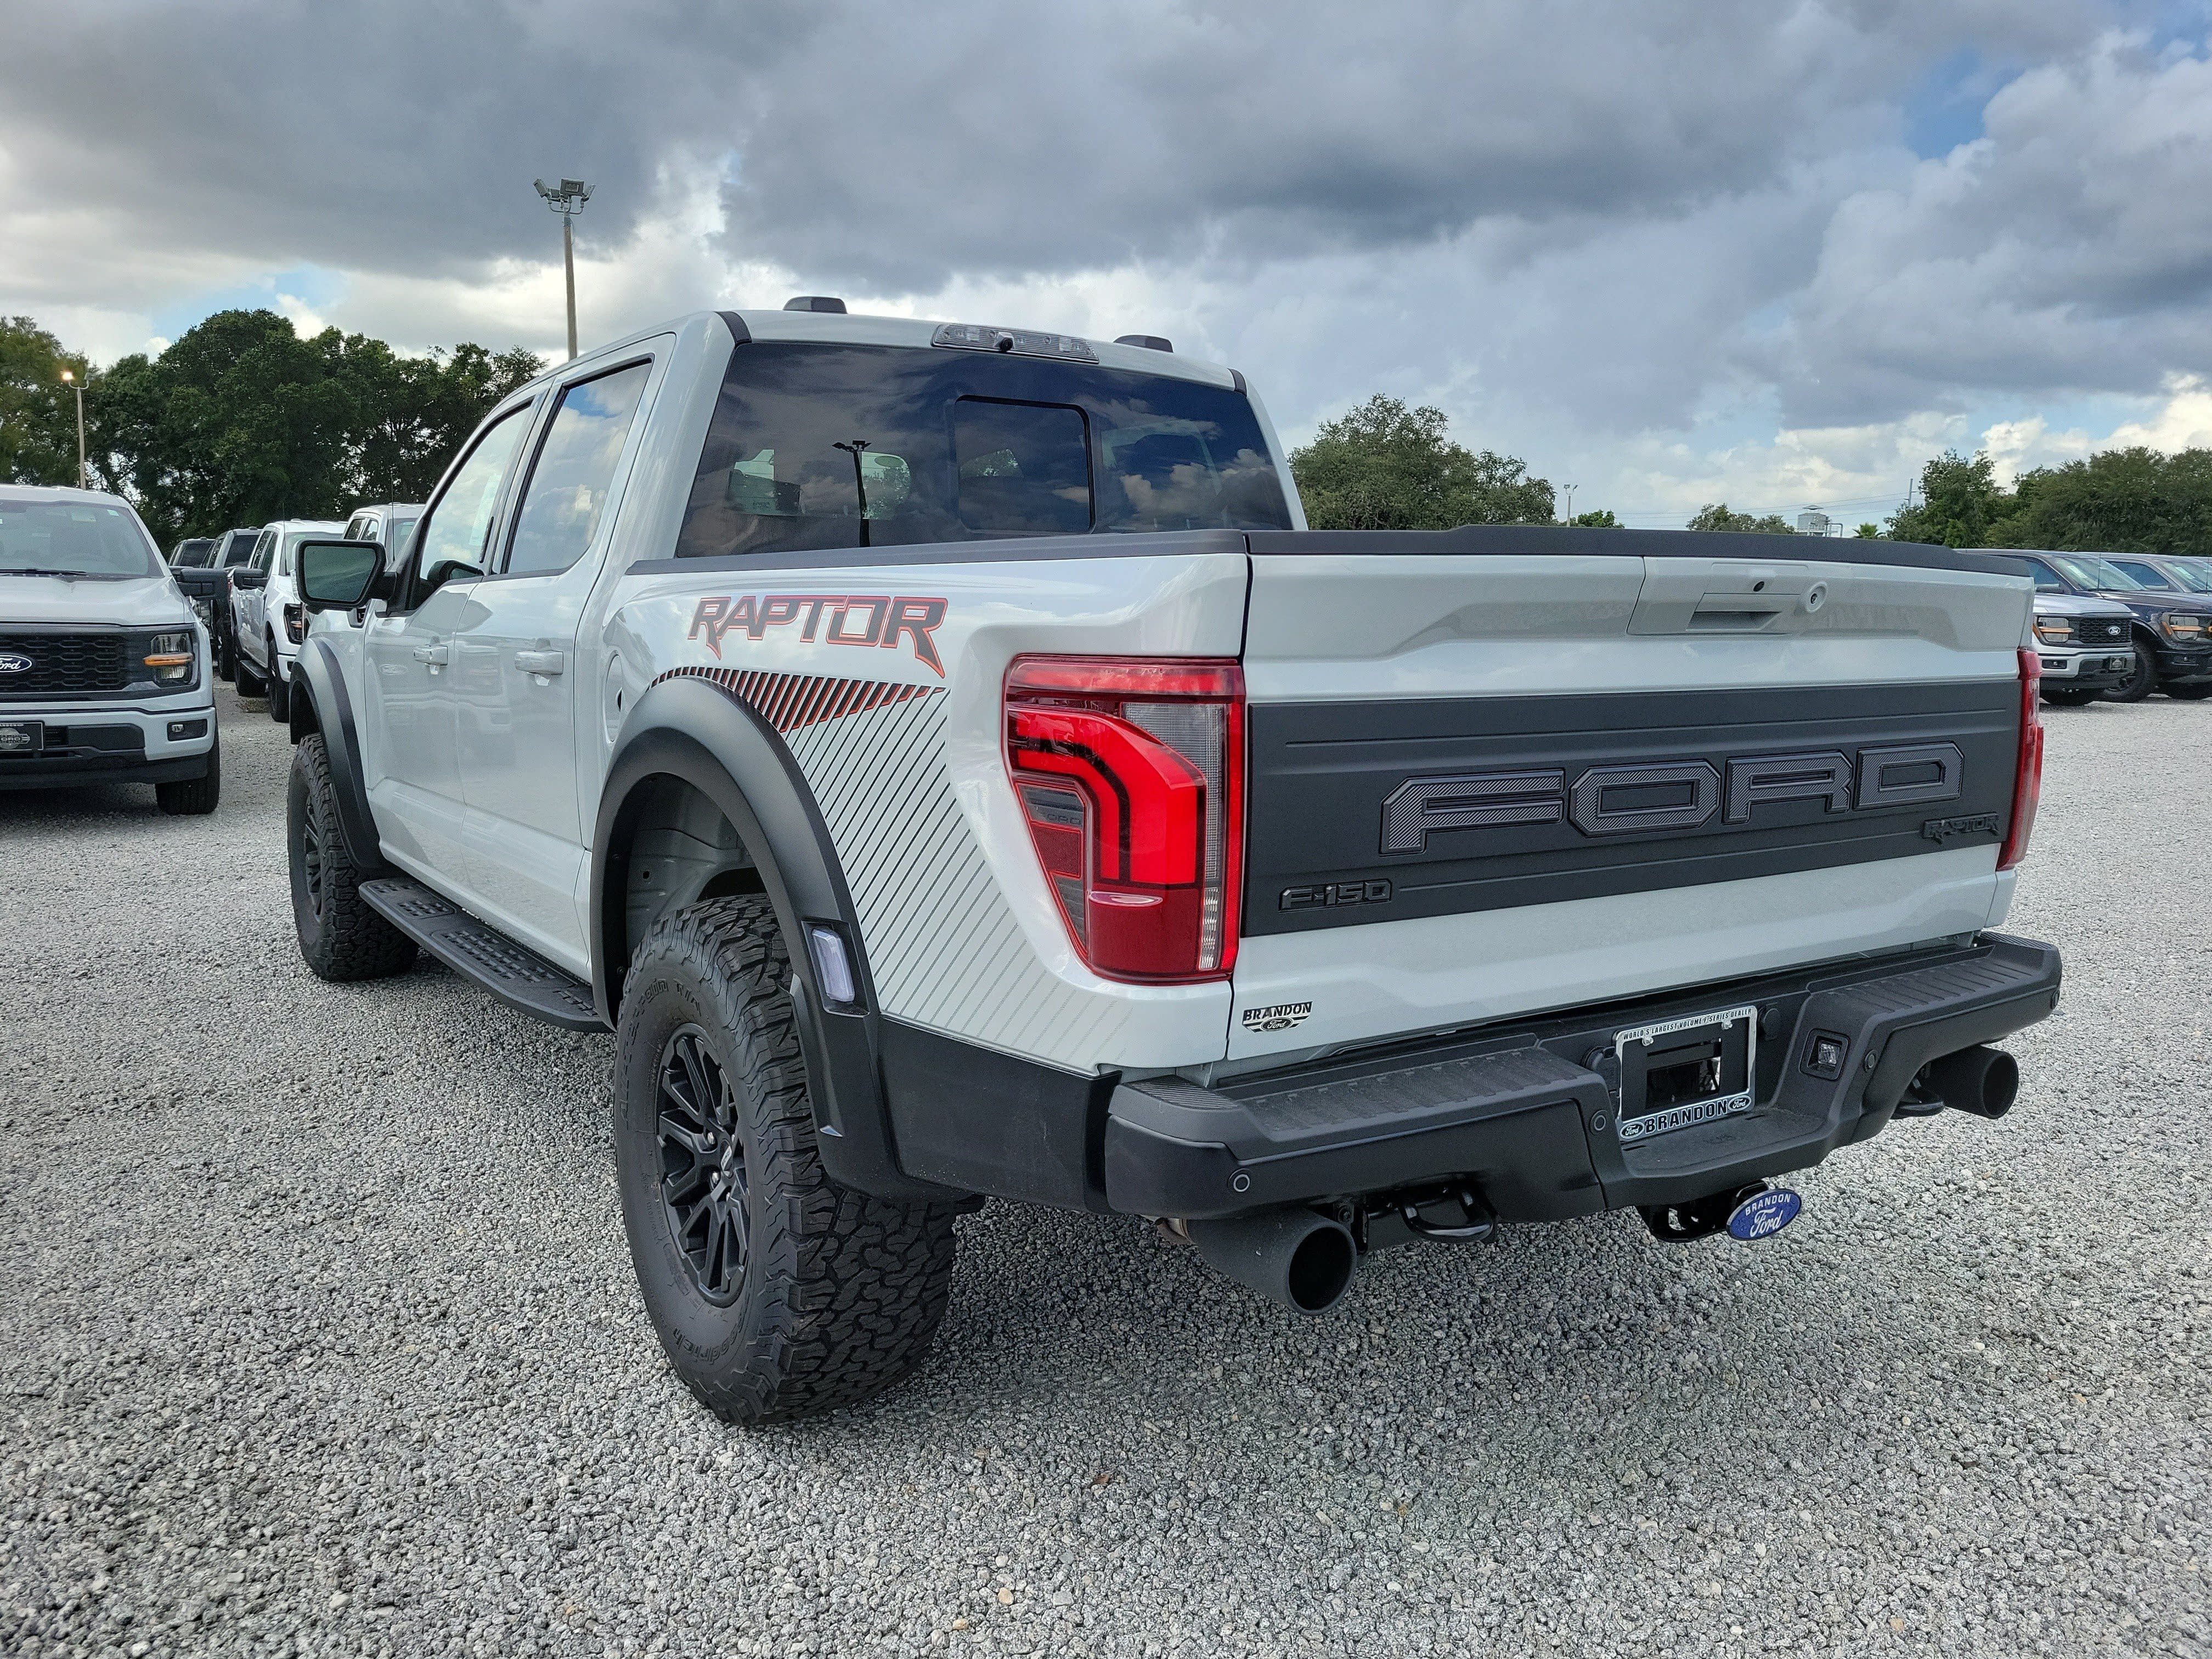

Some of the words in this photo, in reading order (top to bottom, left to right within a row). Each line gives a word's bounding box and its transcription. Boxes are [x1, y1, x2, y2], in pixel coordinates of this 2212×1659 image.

[687, 595, 949, 679] RAPTOR
[1379, 741, 1965, 857] FORD
[1922, 812, 1999, 844] RAPTOR
[1279, 878, 1391, 913] F-150
[1243, 1001, 1313, 1021] BRANDON
[1267, 1019, 1287, 1029] Ford
[1651, 1023, 1678, 1034] LARGEST
[1679, 1018, 1702, 1028] VOLUME
[1703, 1012, 1729, 1023] F-SERIES
[1730, 1008, 1752, 1018] DEALER
[1625, 1125, 1639, 1136] Ford
[1645, 1099, 1728, 1135] BRANDON
[1733, 1099, 1747, 1109] Ford
[1745, 1193, 1791, 1216] BRANDON
[1750, 1207, 1783, 1237] Ford
